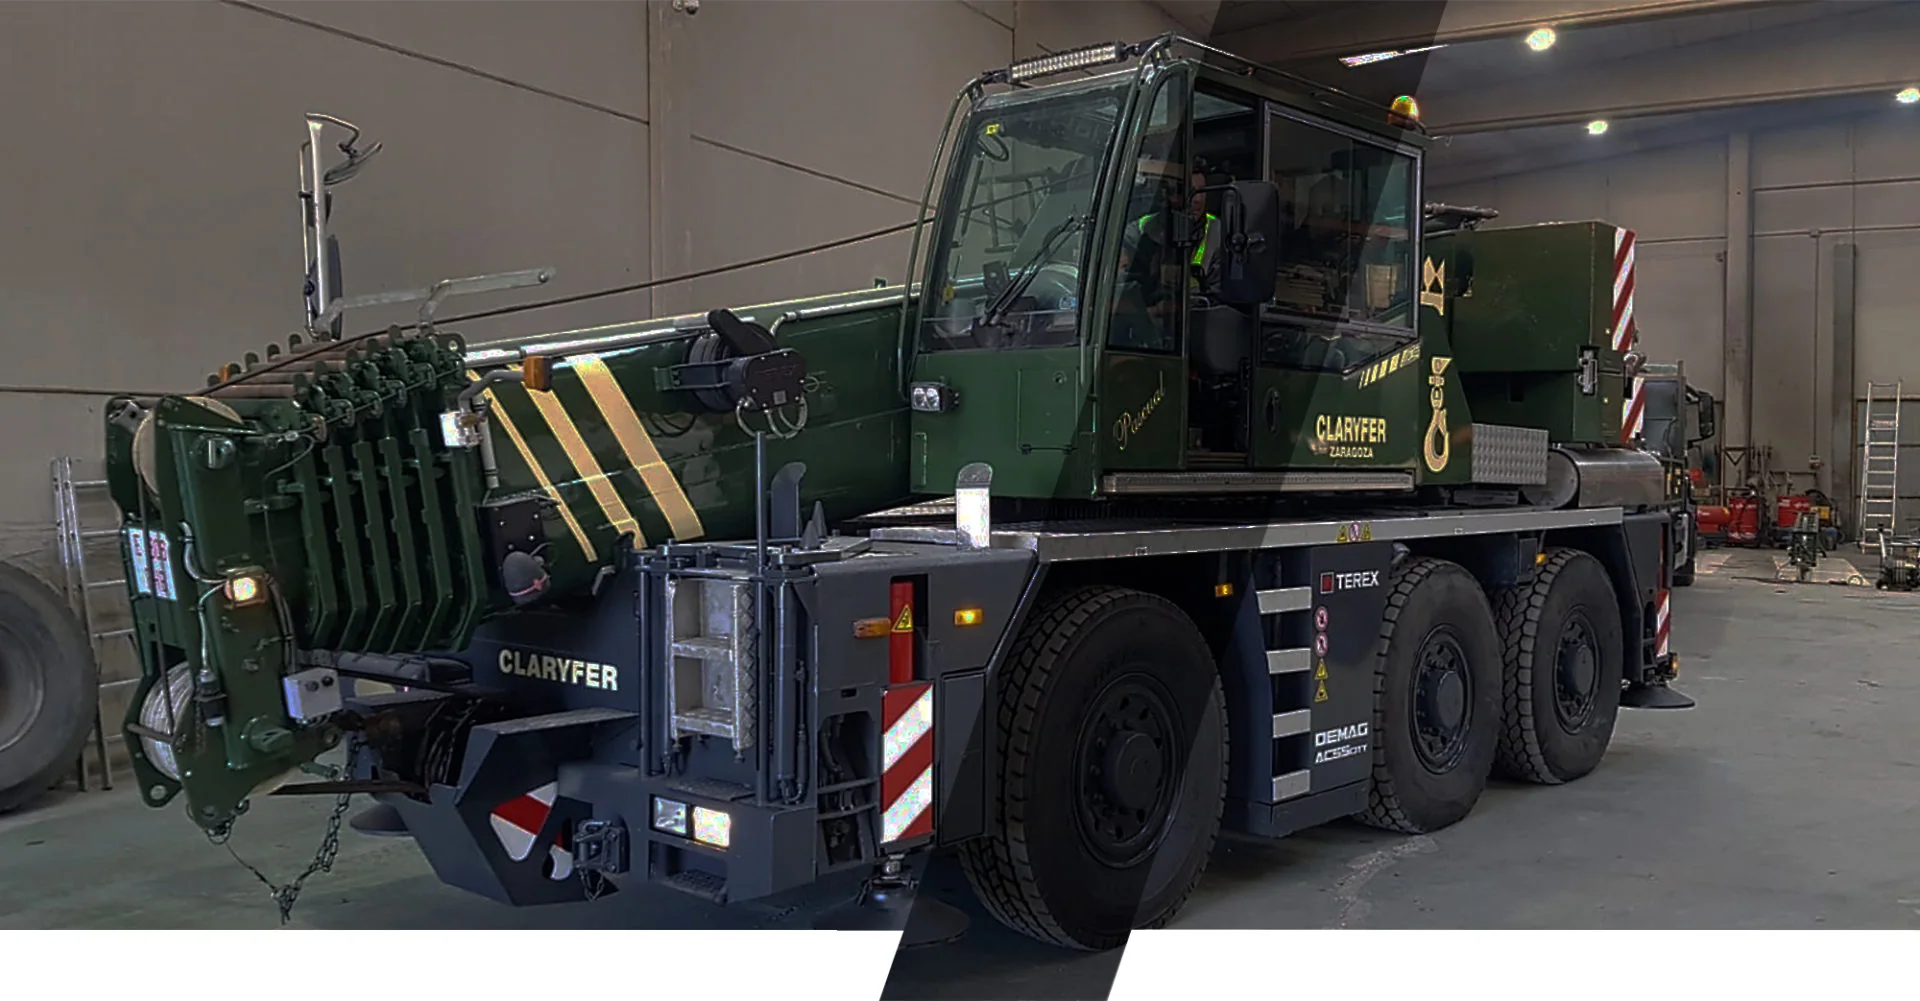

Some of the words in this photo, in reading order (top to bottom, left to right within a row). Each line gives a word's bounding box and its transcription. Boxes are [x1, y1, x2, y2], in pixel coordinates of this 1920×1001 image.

[1112, 369, 1165, 451] Pascual
[1316, 414, 1386, 443] CLARYFER
[1329, 445, 1374, 458] ZARAGOZA
[1336, 570, 1380, 590] TEREX
[498, 648, 618, 691] CLARYFER
[1315, 722, 1368, 747] DEMAG
